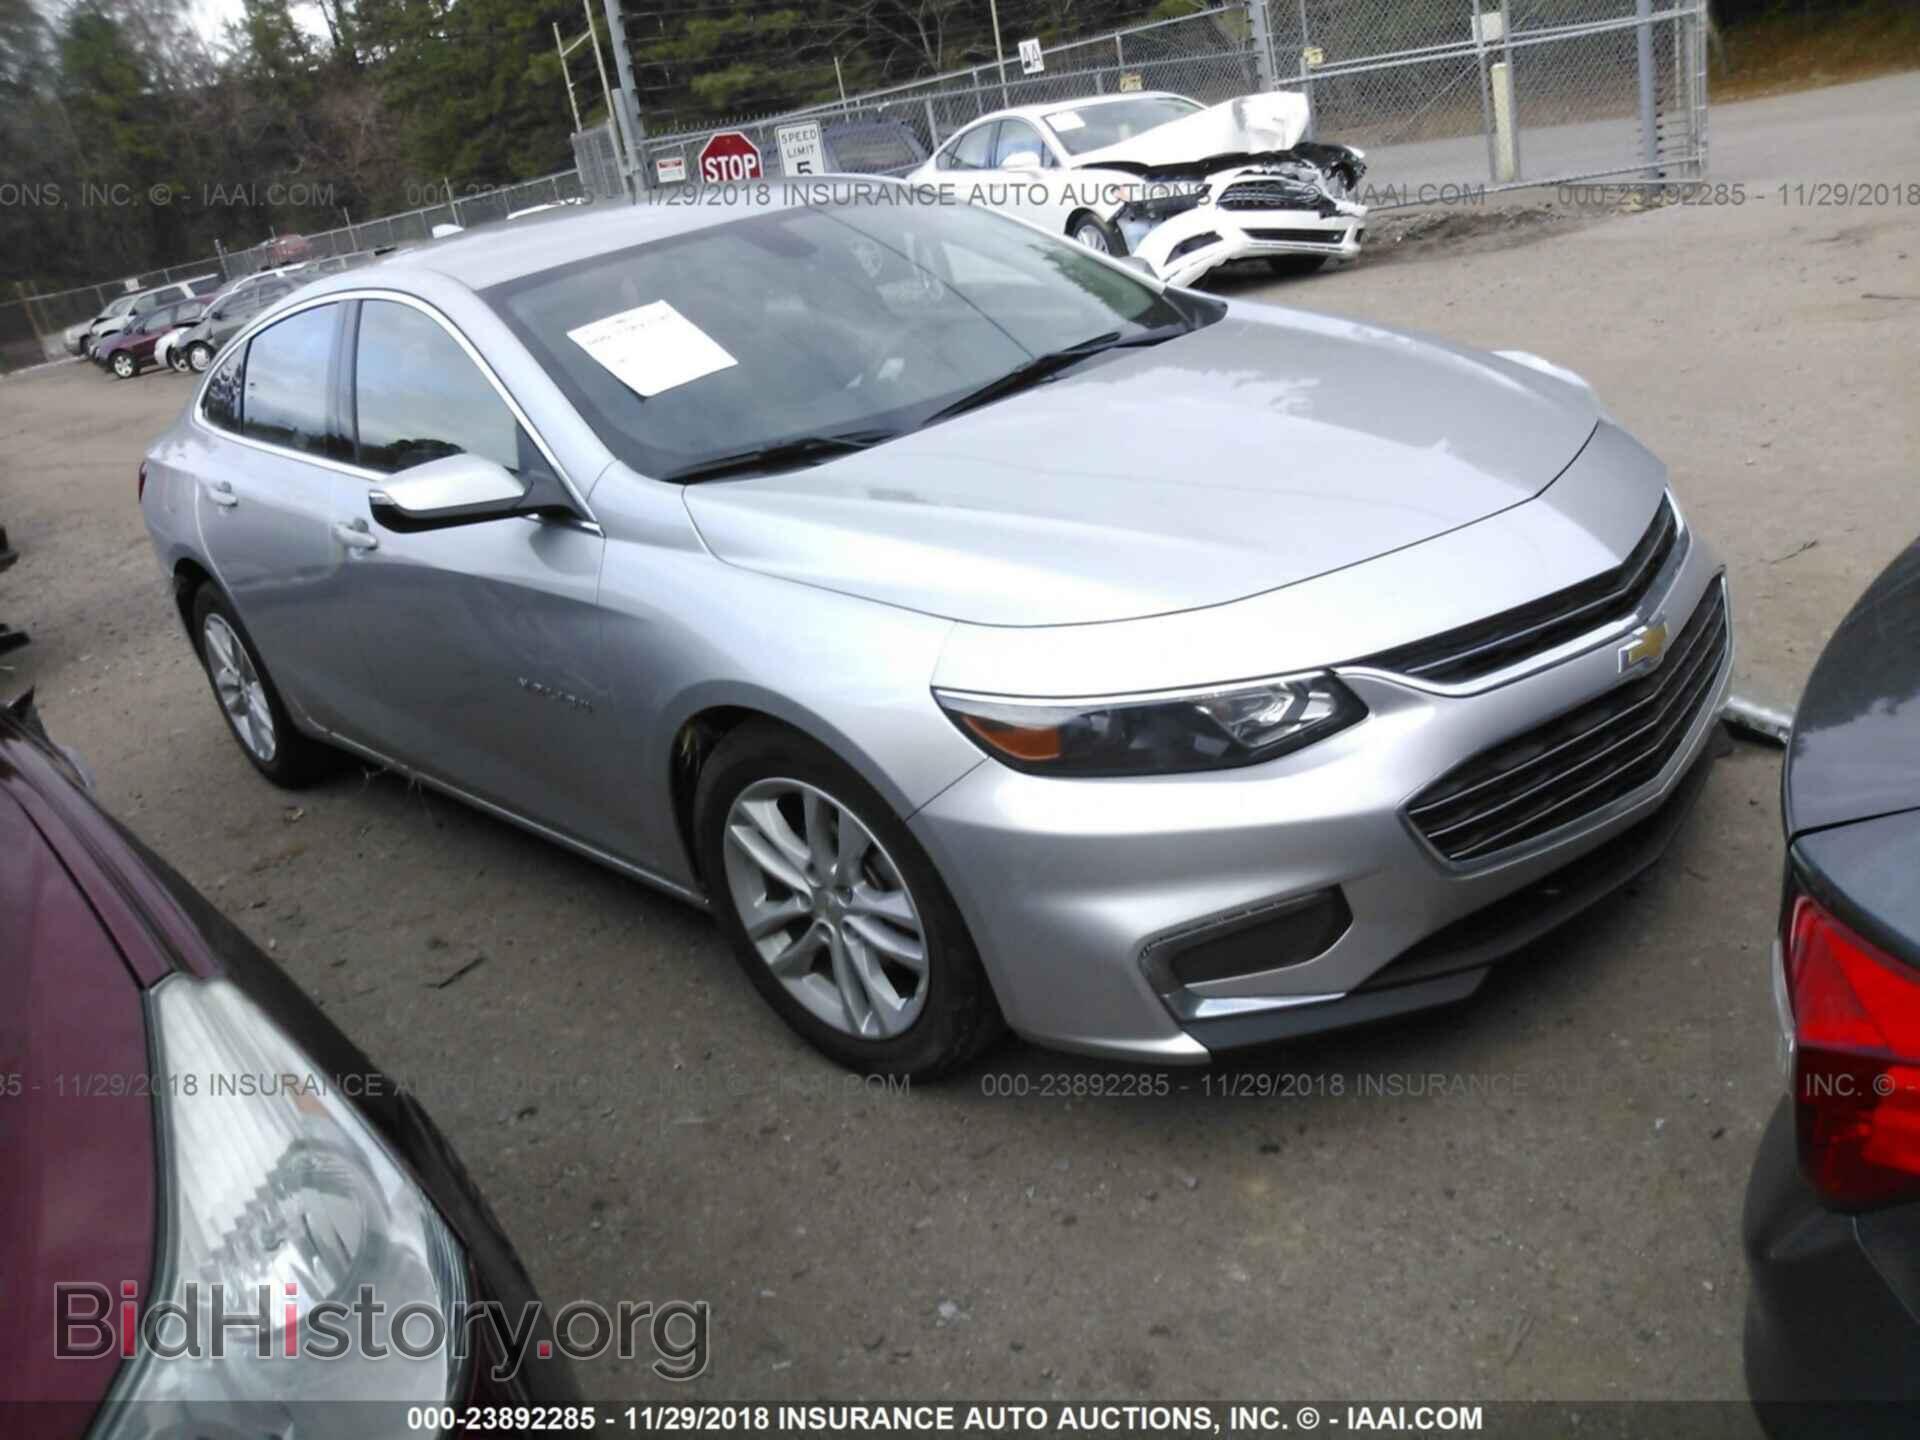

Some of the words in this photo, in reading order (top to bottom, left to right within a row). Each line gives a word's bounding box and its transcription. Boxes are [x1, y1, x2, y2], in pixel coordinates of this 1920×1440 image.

[781, 128, 817, 144] SPEED
[787, 145, 815, 158] LIMIT
[704, 153, 757, 183] STOP
